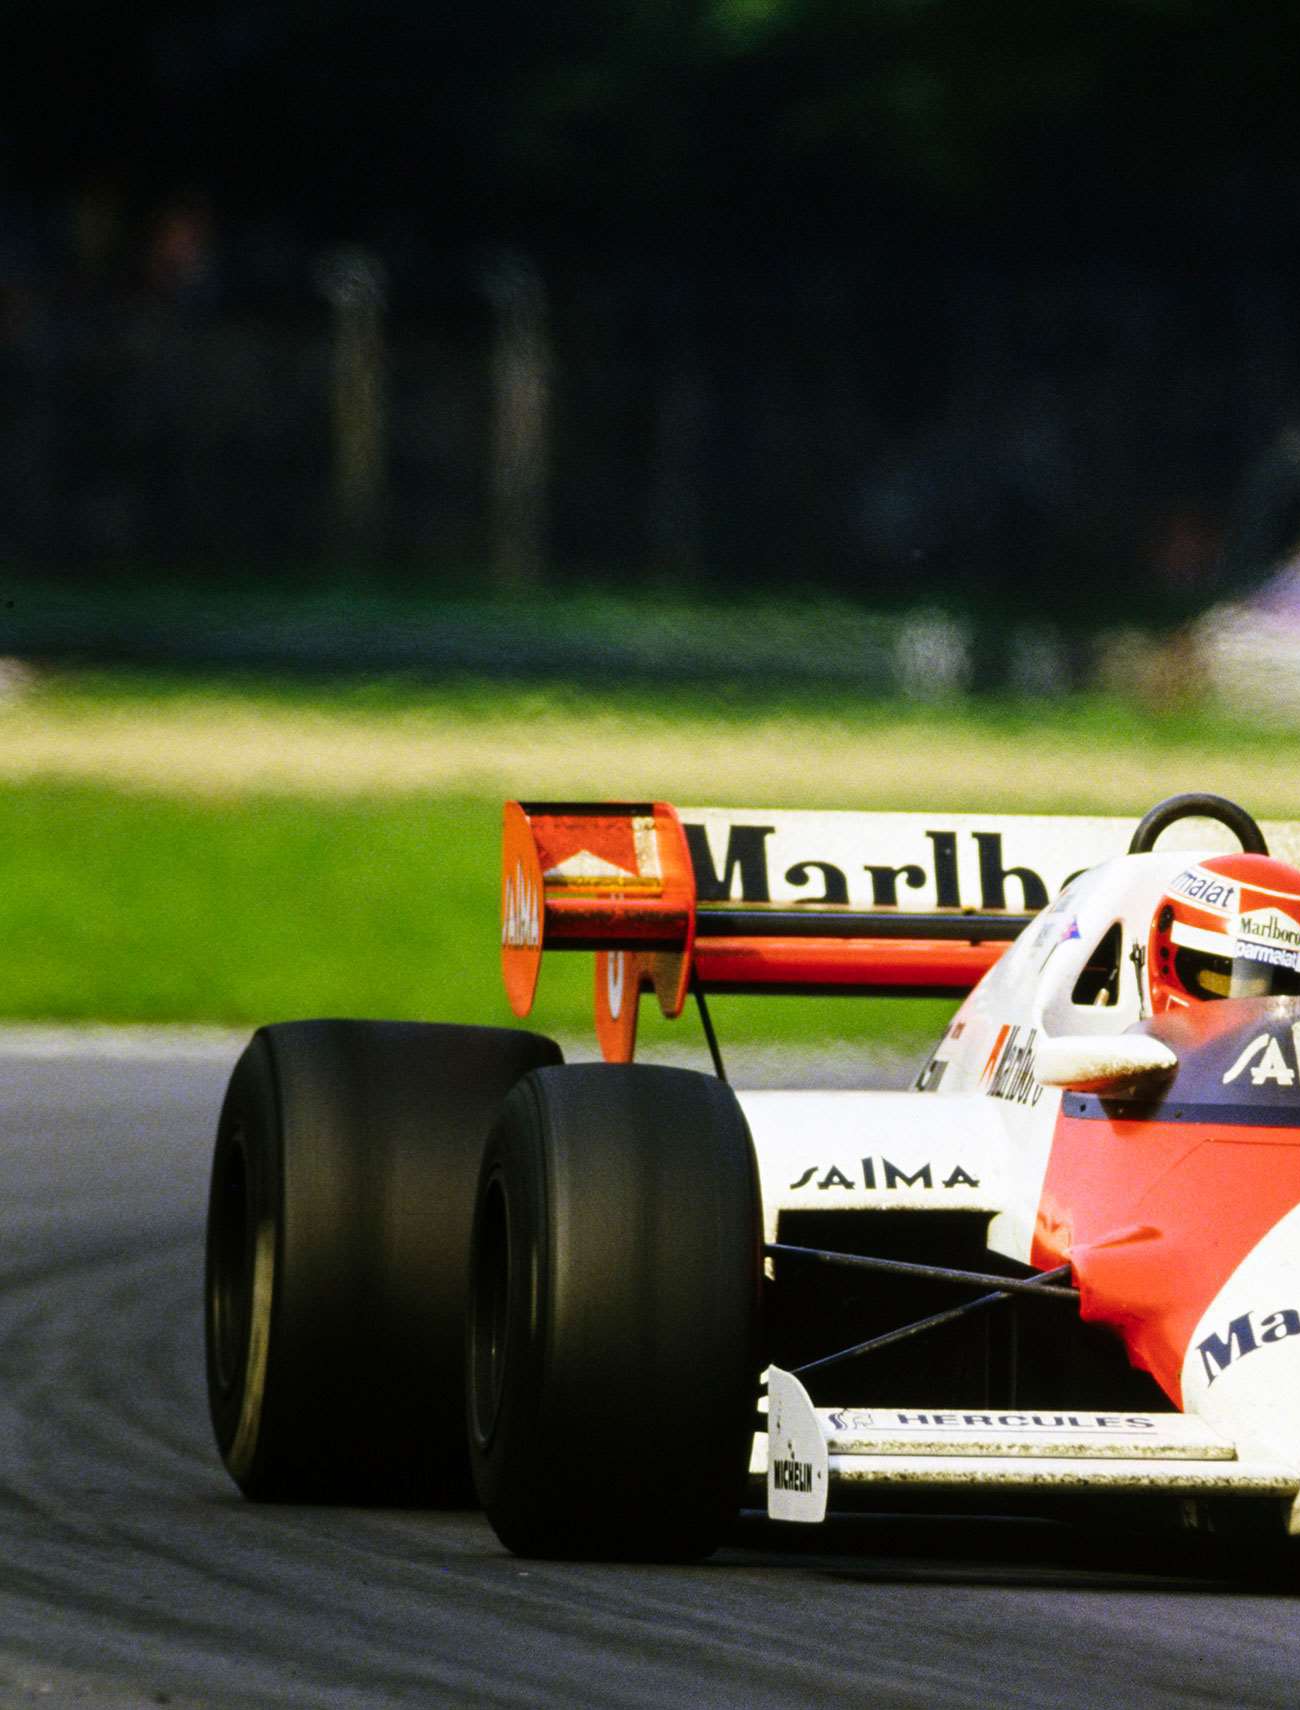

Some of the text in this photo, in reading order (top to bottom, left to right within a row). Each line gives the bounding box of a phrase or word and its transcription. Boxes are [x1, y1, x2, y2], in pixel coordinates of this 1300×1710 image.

[684, 822, 1088, 910] Marlb
[1236, 942, 1297, 969] parmalat
[790, 1156, 980, 1190] SAIMA
[899, 1413, 1155, 1430] HERCULES
[774, 1460, 812, 1492] MICHELIN
